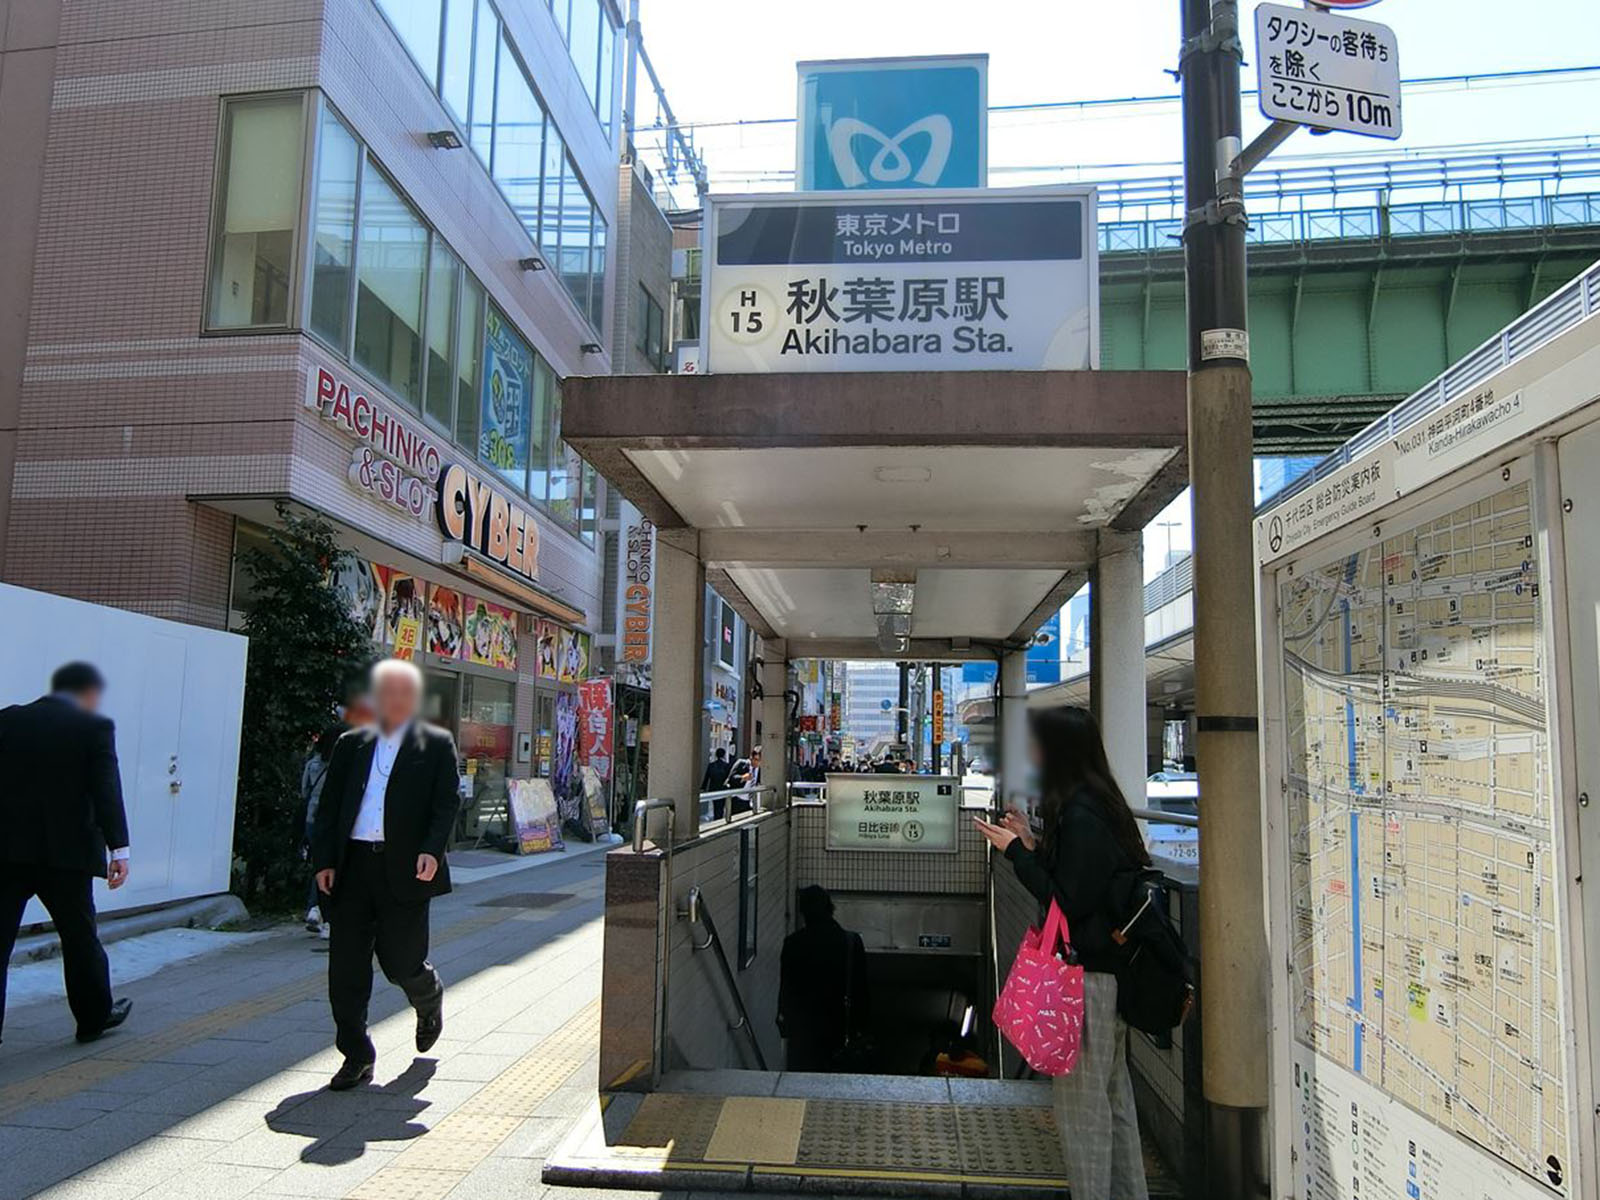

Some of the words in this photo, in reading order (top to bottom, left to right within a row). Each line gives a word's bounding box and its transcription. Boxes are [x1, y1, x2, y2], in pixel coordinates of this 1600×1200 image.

[1267, 16, 1389, 63] タクシーの客待ち
[1269, 49, 1321, 81] を除く
[835, 213, 960, 237] 東京メトロ
[843, 240, 895, 260] Tokyo
[899, 239, 953, 256] Metro
[740, 291, 756, 308] H
[785, 275, 1010, 325] 秋葉原駅
[730, 312, 763, 334] 15
[781, 328, 942, 354] Akihabara
[952, 327, 1014, 354] Sta.
[314, 366, 441, 482] PACHINKO
[1427, 399, 1511, 456] Kanda-Hirakawacho
[1512, 394, 1521, 409] 4
[359, 447, 376, 490] &
[379, 461, 438, 521] SLOT
[1315, 459, 1382, 512] 総合防災案内板
[438, 463, 541, 581] CYBER
[1313, 507, 1341, 531] Emergency
[1341, 499, 1358, 516] Guide
[1357, 491, 1376, 508] Board
[626, 539, 639, 584] SLOT
[624, 583, 652, 665] CYBER
[863, 789, 921, 805] 秋葉原駅
[863, 805, 904, 813] Akihabara
[904, 805, 920, 813] Sta.
[907, 830, 920, 838] 15
